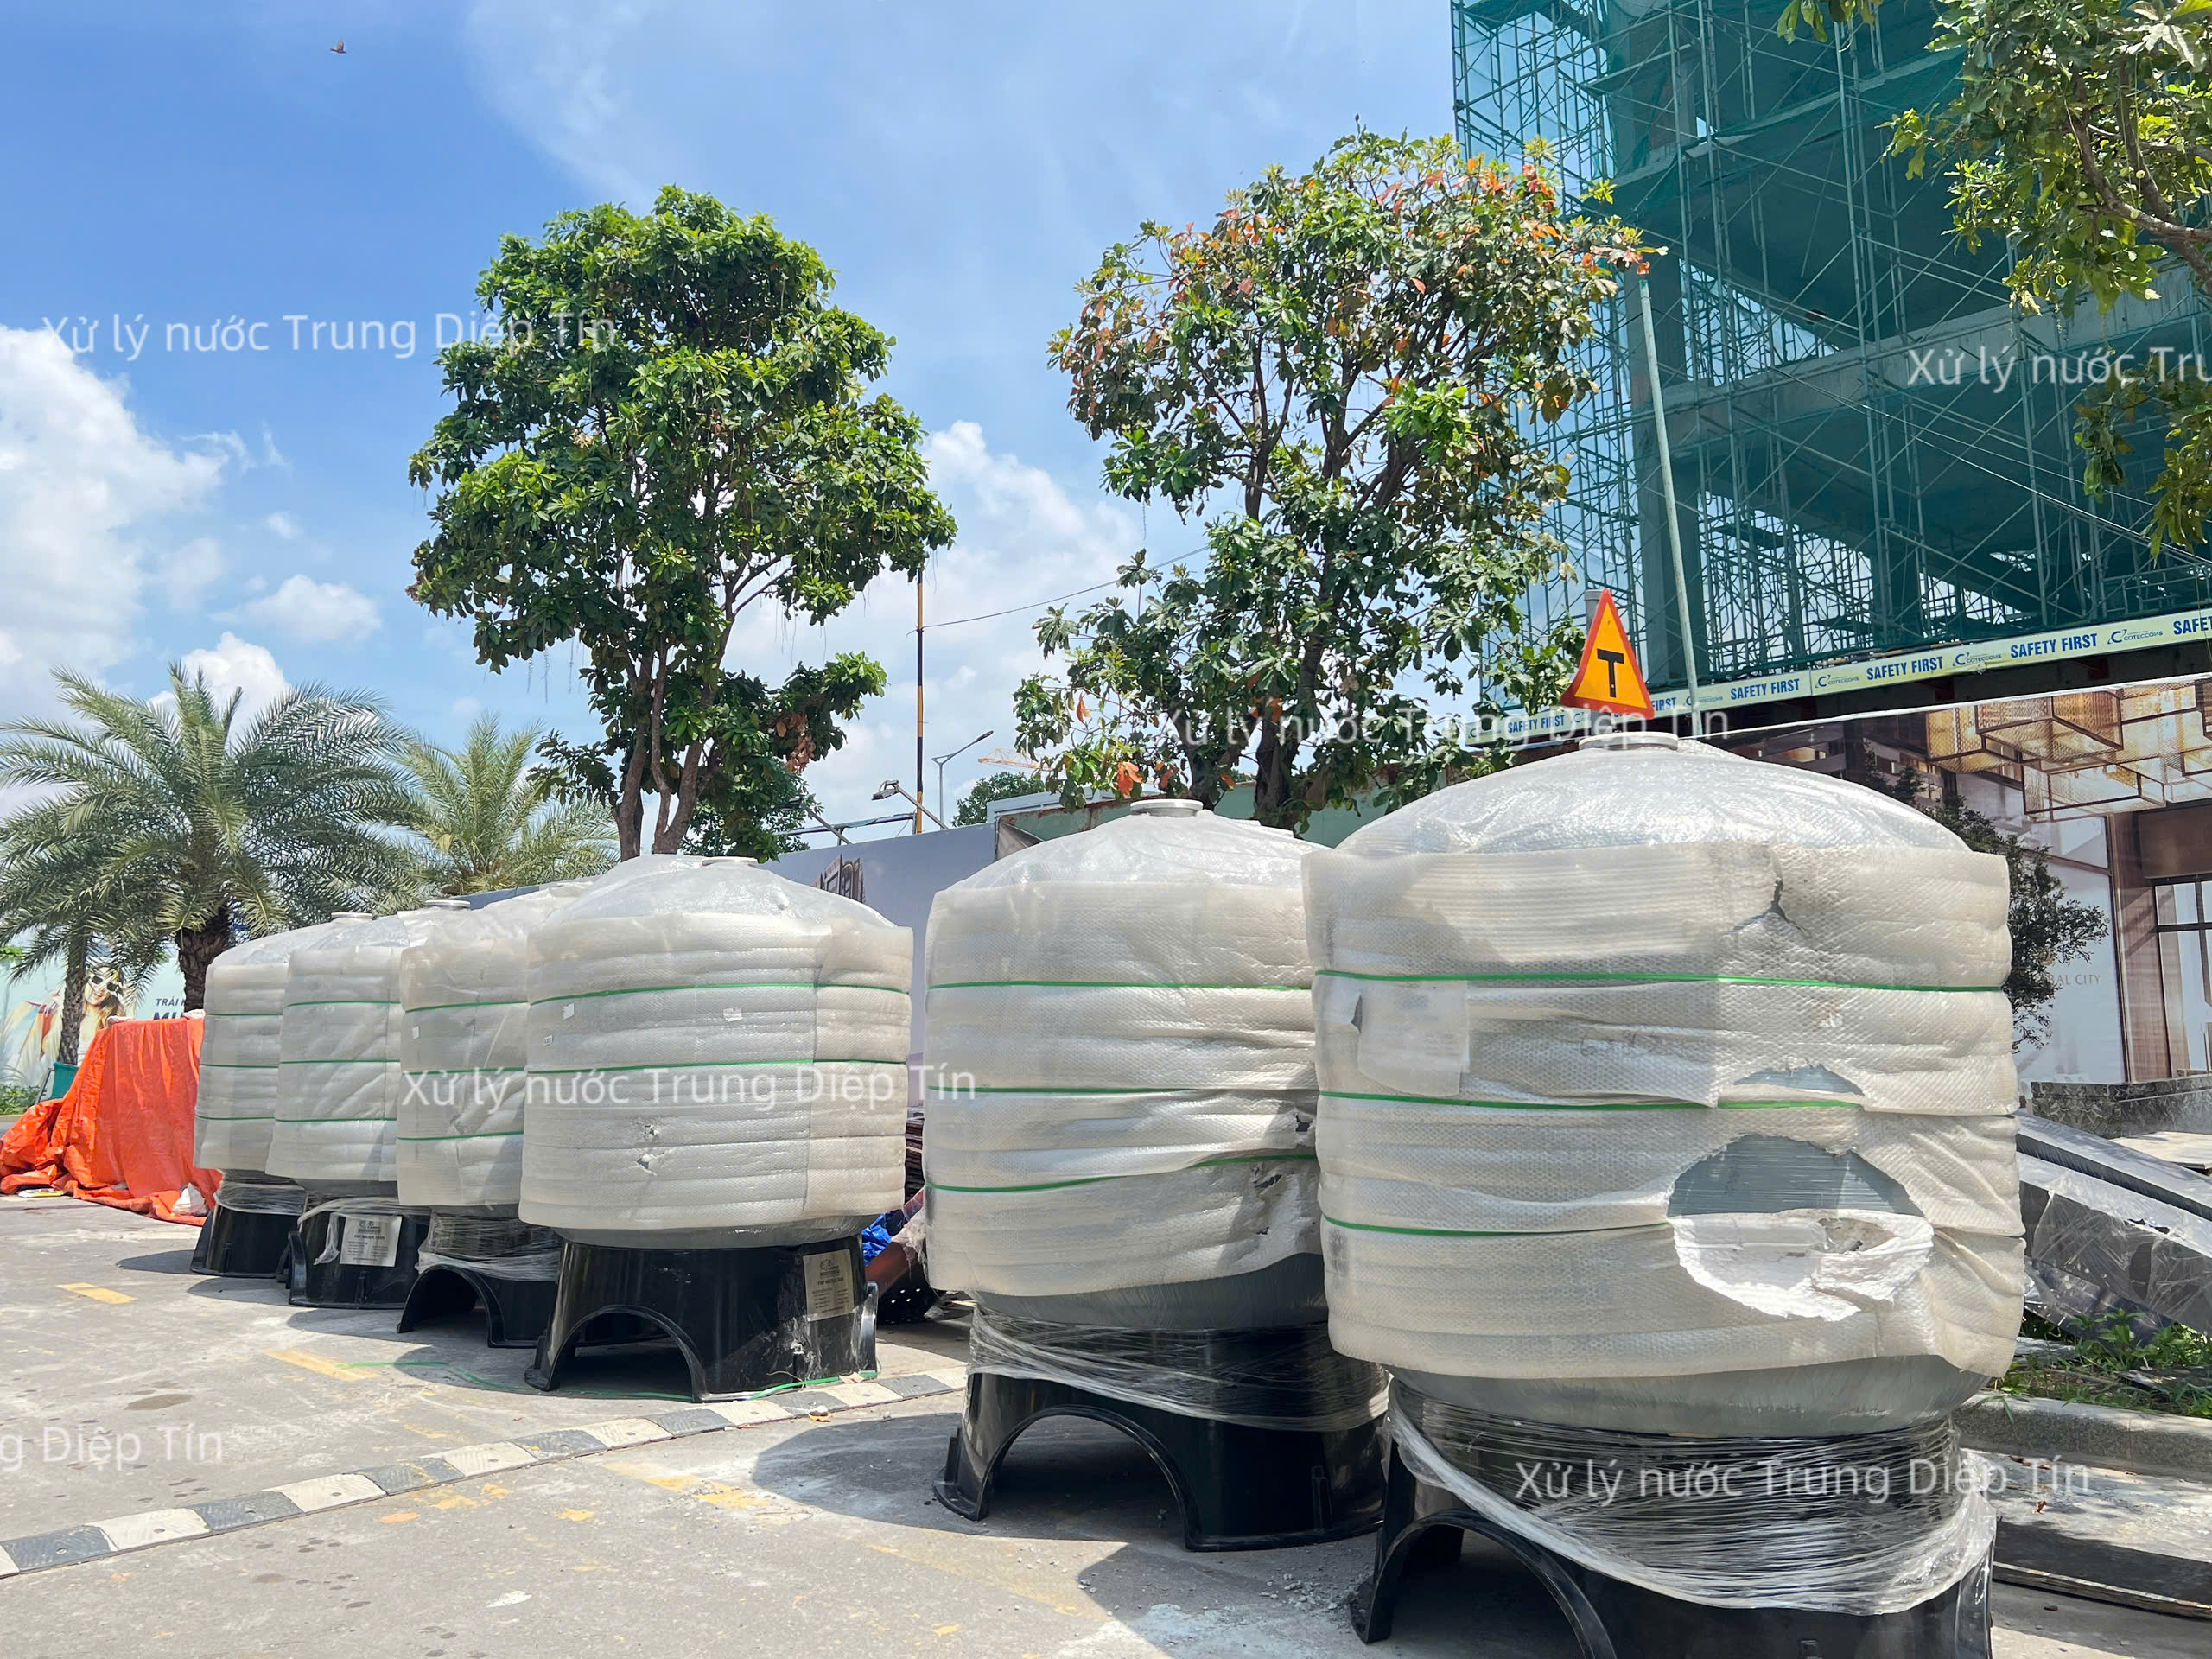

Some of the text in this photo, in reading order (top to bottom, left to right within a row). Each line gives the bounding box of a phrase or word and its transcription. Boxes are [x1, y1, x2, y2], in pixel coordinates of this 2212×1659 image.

[2011, 633, 2098, 658] SAFETY FIRST
[1597, 648, 1624, 698] T
[1866, 656, 1943, 680] SAFETY FIRST
[1731, 678, 1800, 700] SAFETY FIRST
[1508, 715, 1566, 734] SAFETY FIRST
[2075, 974, 2101, 985] CITY
